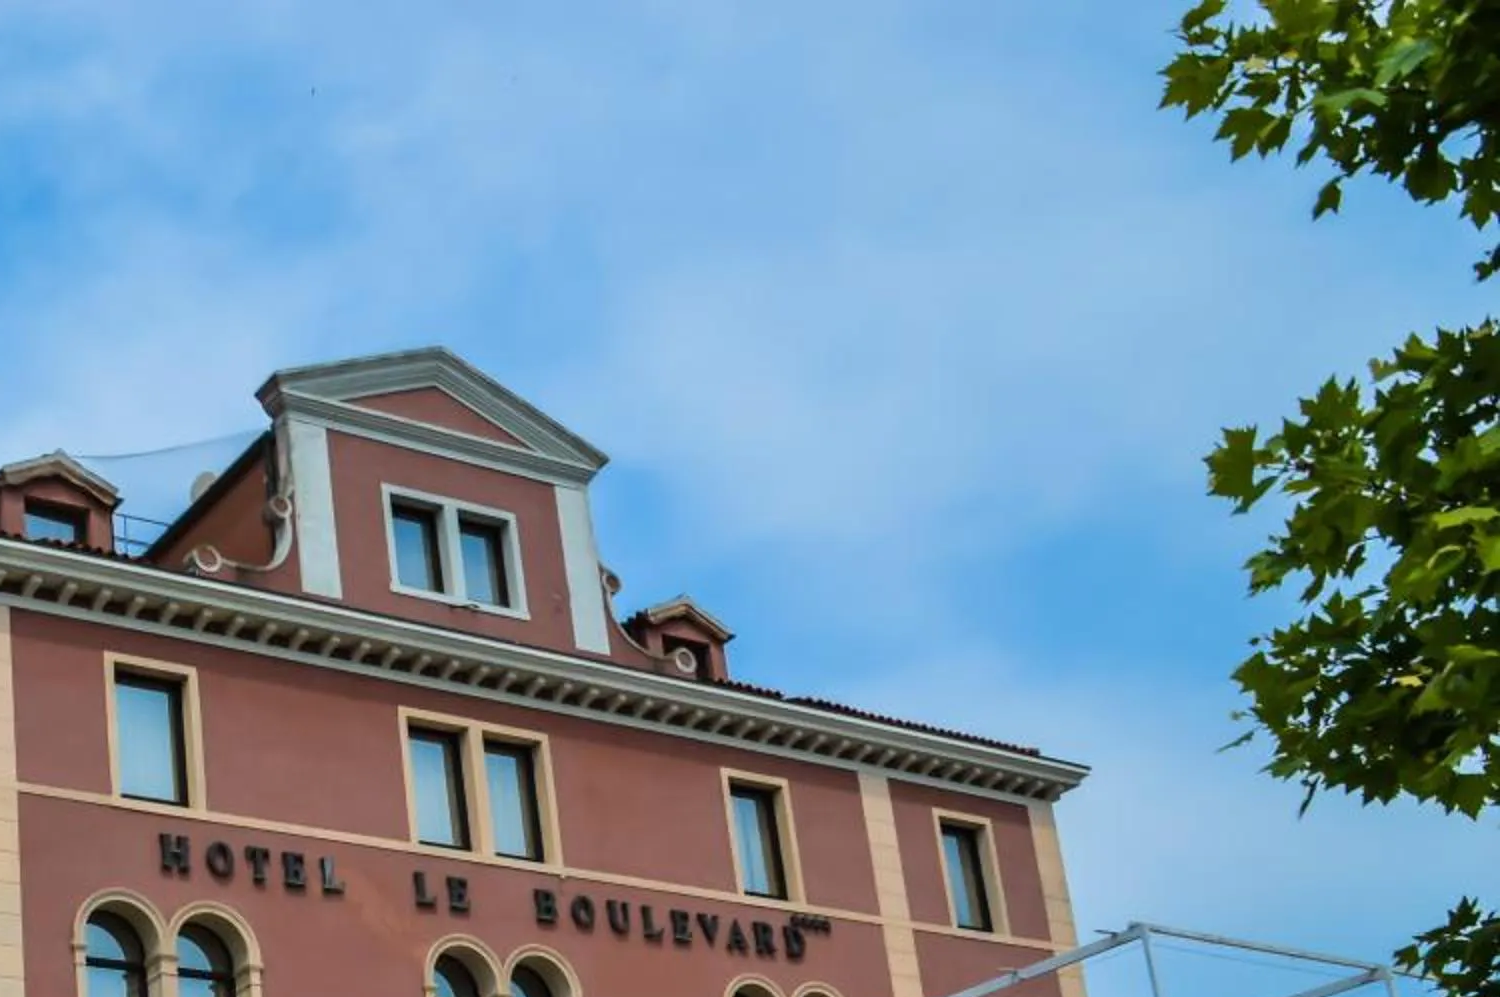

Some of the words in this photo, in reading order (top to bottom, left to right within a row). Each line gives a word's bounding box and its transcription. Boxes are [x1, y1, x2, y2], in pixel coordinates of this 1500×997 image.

[158, 833, 345, 894] HOTEL
[413, 871, 469, 911] LE
[533, 888, 806, 958] BOULEVARD
